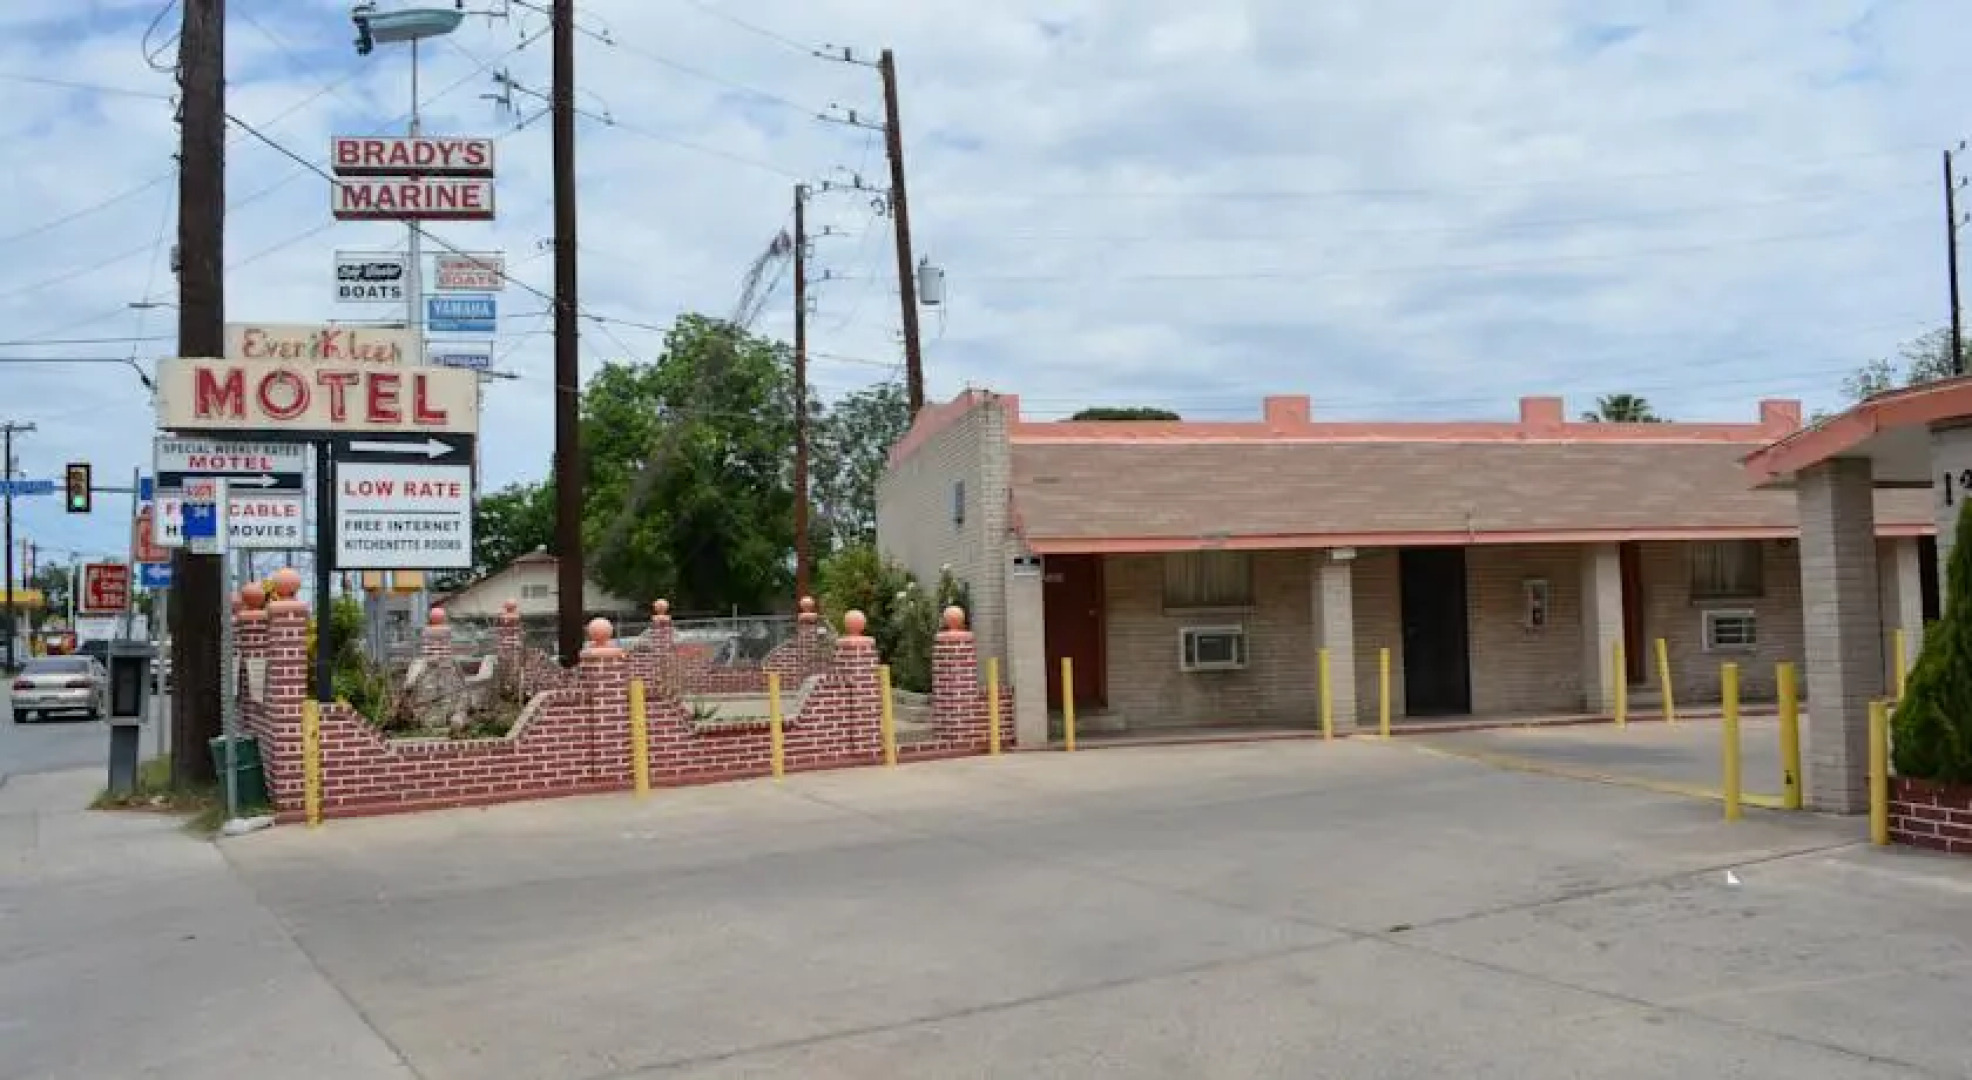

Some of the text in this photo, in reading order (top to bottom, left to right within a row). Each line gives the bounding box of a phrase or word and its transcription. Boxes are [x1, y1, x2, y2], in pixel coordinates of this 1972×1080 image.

[337, 139, 485, 166] BRADY'S
[341, 184, 481, 208] MARINE
[339, 285, 402, 299] BOATS
[433, 301, 489, 317] YAMAHA
[194, 365, 449, 425] MOTEL
[164, 442, 210, 454] SPECIAL
[188, 454, 273, 471] MOTEL
[344, 479, 461, 499] LOW RATE
[229, 504, 297, 517] CABLE
[229, 524, 297, 537] MOVIES
[344, 520, 460, 532] FREE INTERNET
